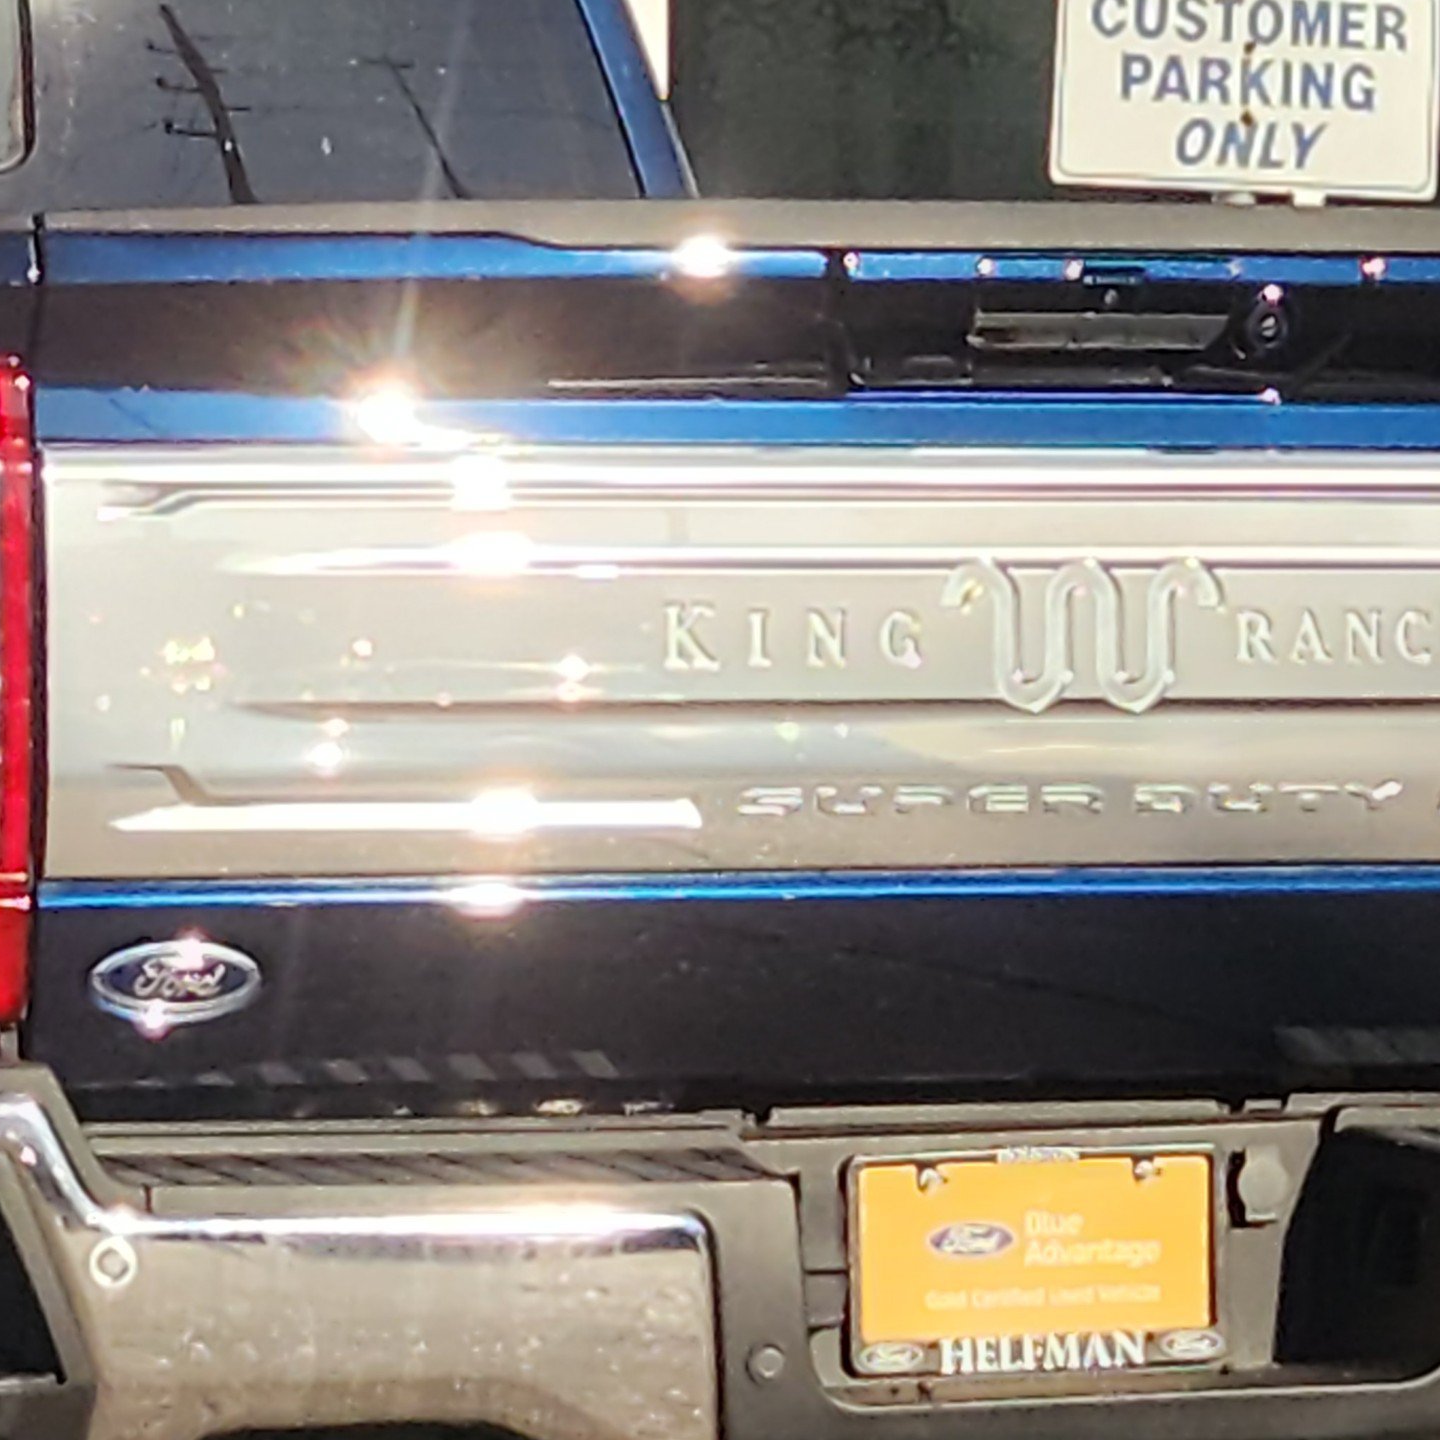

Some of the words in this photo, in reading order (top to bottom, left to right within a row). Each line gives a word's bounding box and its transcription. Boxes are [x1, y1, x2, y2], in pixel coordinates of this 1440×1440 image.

[1121, 52, 1375, 112] PARKING
[1175, 118, 1329, 170] ONLY
[663, 600, 922, 670] KING
[736, 783, 1106, 815] SUPER
[1132, 778, 1406, 815] DUTY
[1023, 1238, 1162, 1268] Advantage
